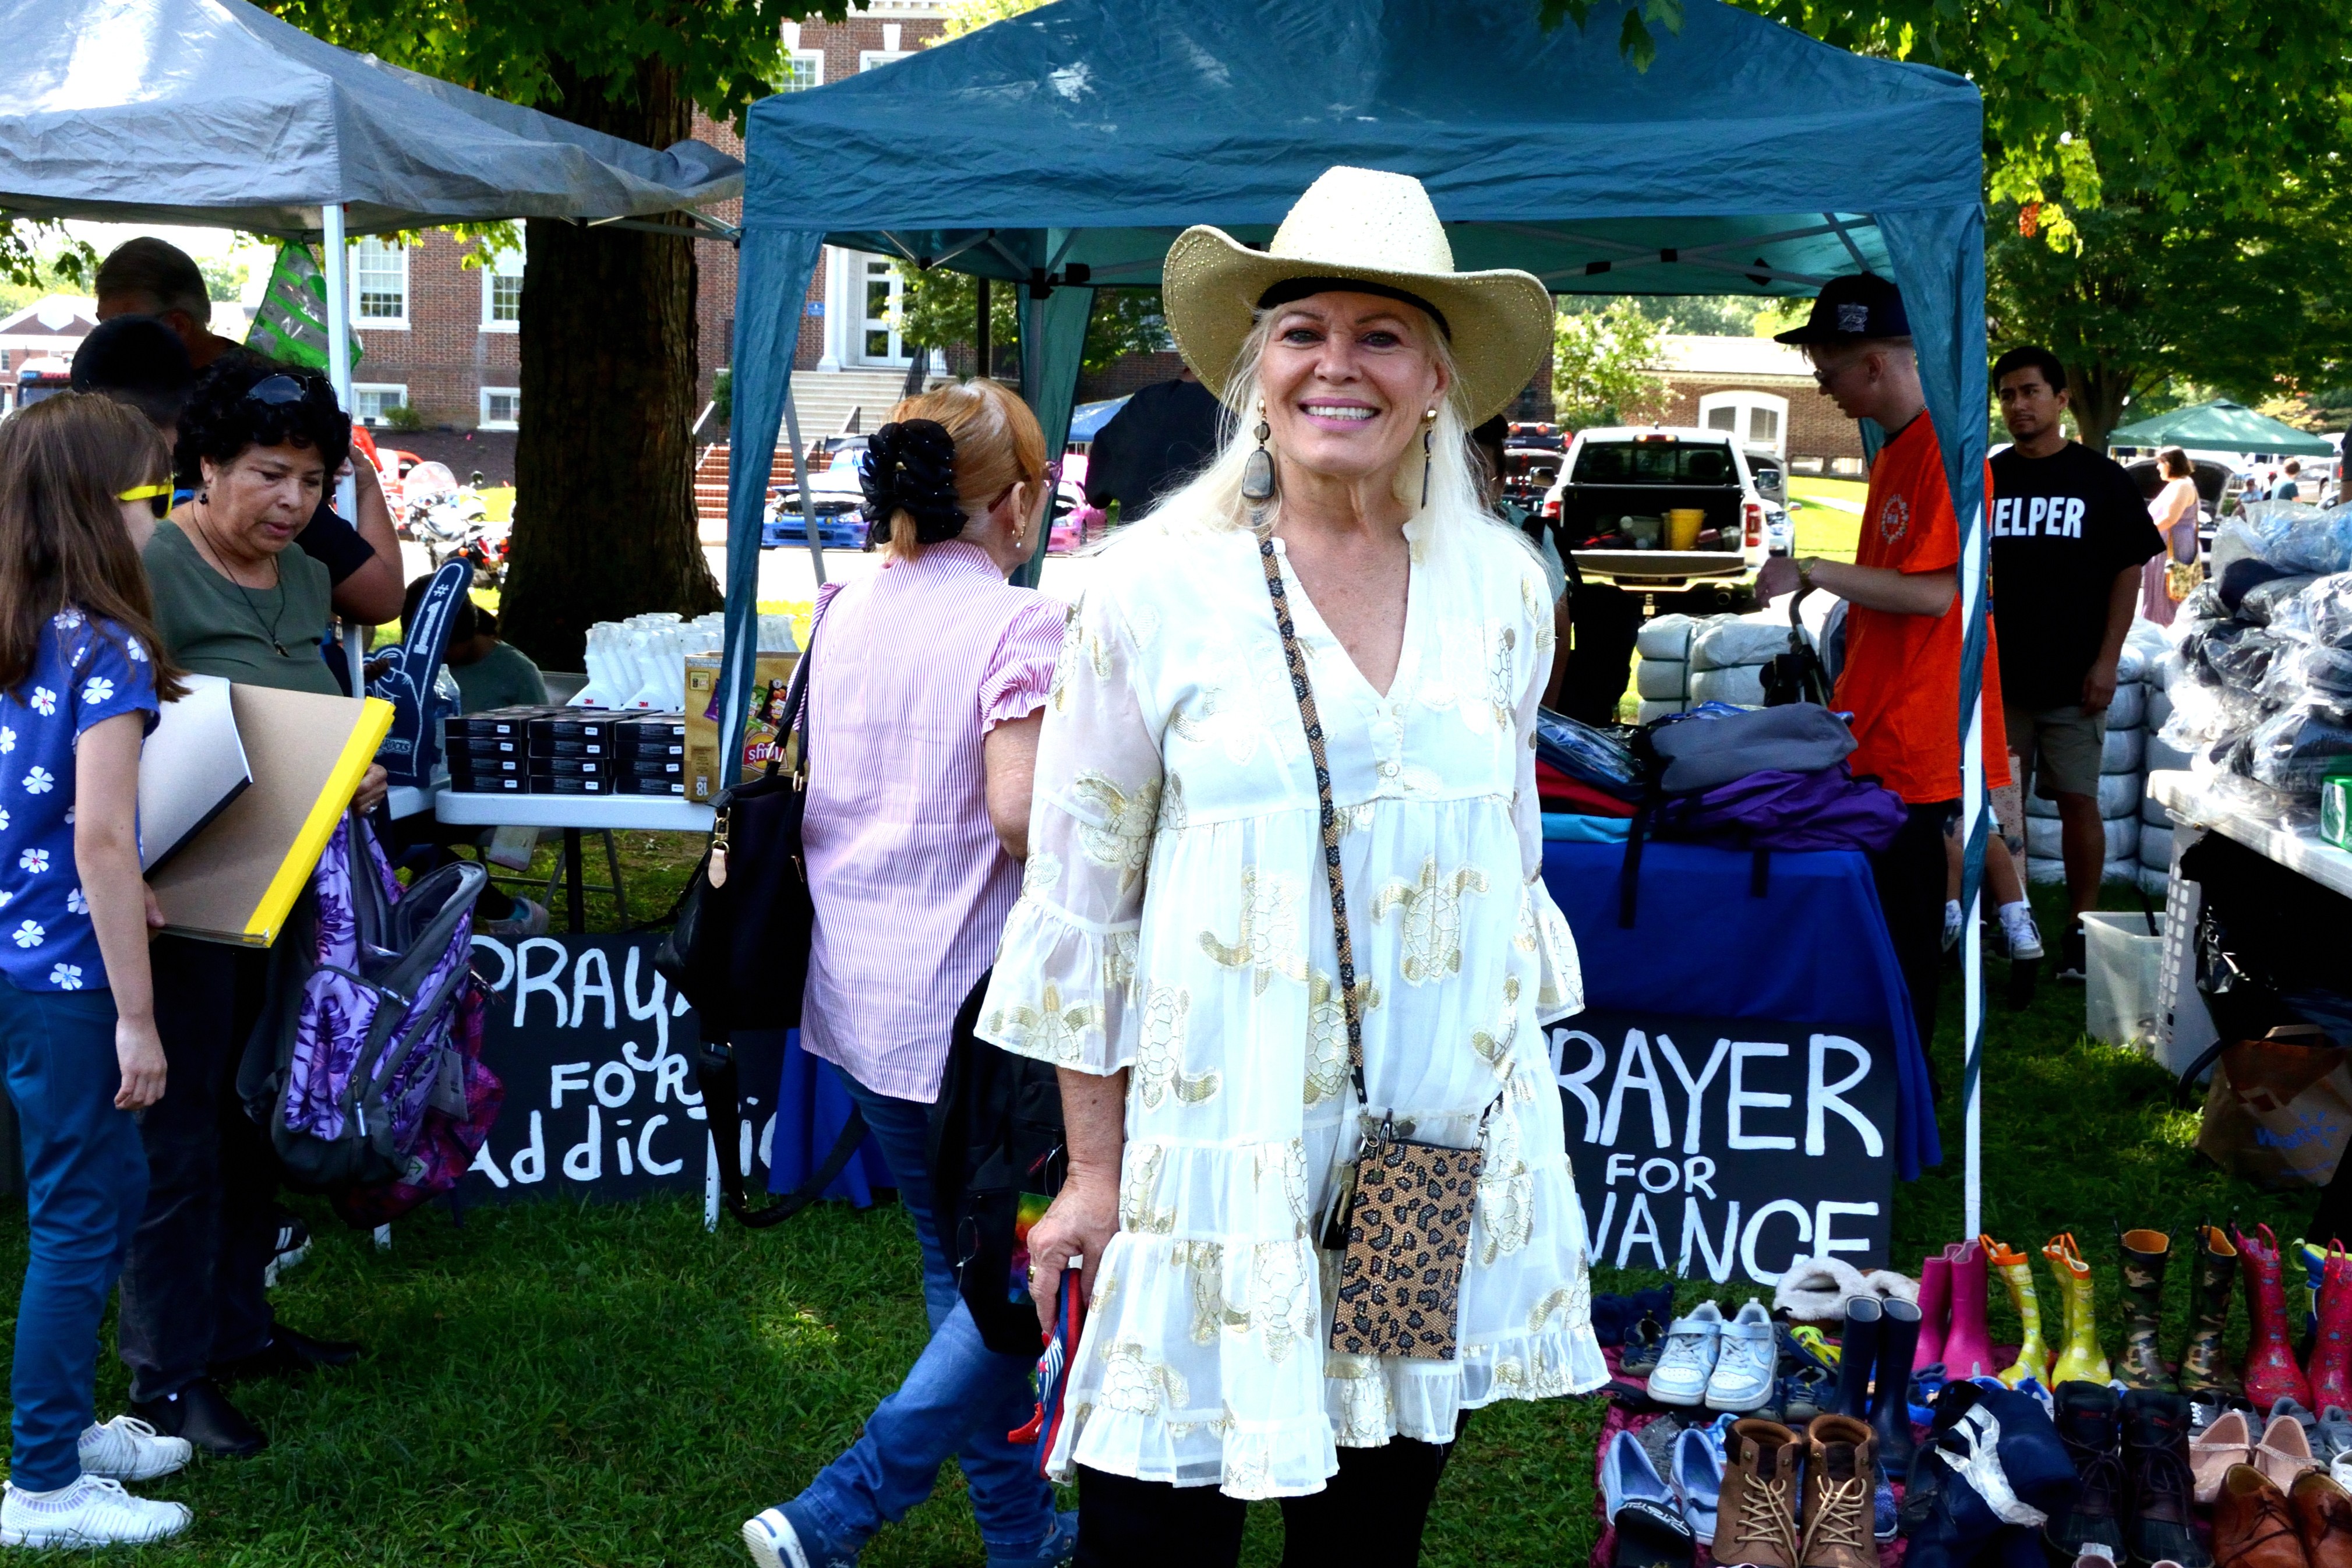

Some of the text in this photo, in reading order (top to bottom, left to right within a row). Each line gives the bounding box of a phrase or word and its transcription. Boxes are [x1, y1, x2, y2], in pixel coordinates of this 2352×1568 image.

[696, 782, 709, 796] 18
[551, 1054, 704, 1108] FOR
[1541, 1027, 1883, 1157] RAYER
[1606, 1153, 1717, 1200] FOR
